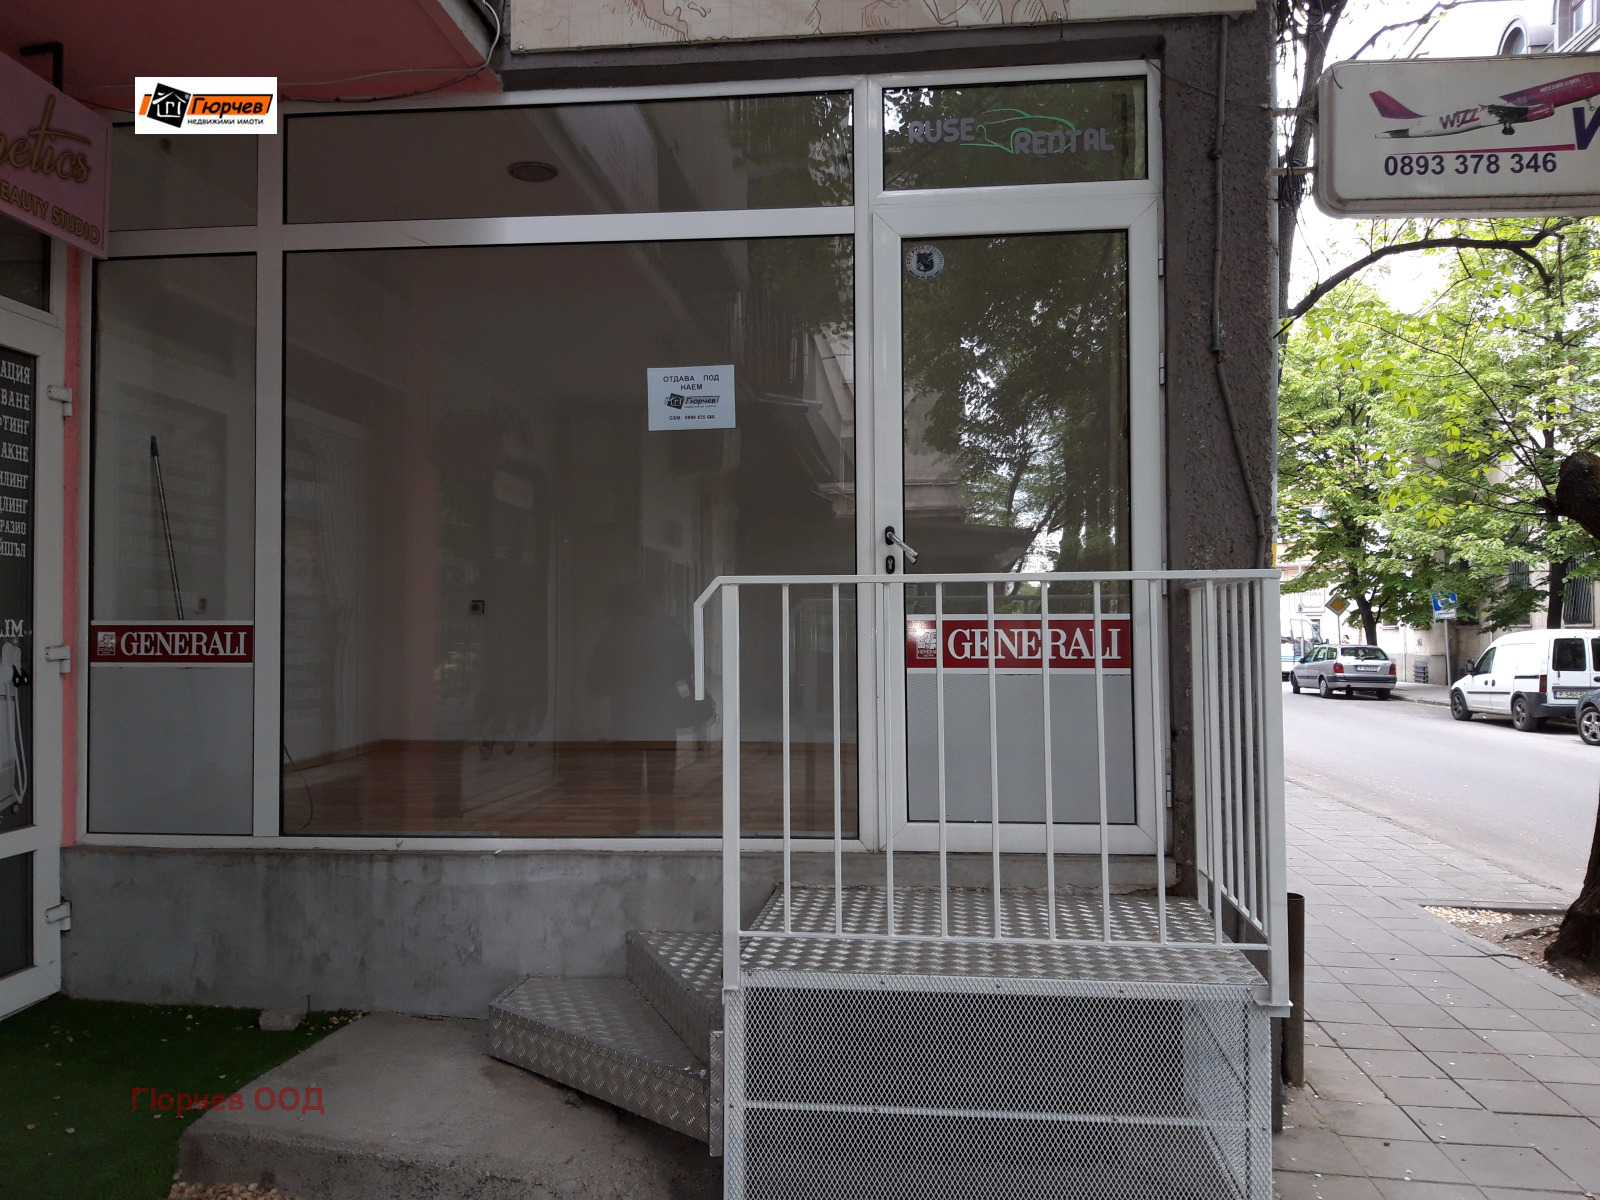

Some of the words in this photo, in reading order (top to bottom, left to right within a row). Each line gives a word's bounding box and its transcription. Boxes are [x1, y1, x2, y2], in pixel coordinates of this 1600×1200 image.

[0, 94, 92, 183] etics
[907, 117, 976, 144] RUSE
[1013, 127, 1116, 156] RENTAL
[1384, 154, 1445, 176] 0893
[1454, 153, 1501, 175] 378
[1510, 152, 1557, 173] 346
[51, 205, 101, 245] STUDIO
[663, 375, 696, 383] ОТДАВА
[703, 374, 720, 382] ПОД
[680, 383, 703, 391] НАЕМ
[685, 397, 716, 405] Гюрчев
[0, 414, 30, 436] ТИНГ
[1, 441, 30, 463] АКНЕ
[120, 630, 248, 657] GENERALI
[947, 627, 1122, 660] GENERALI
